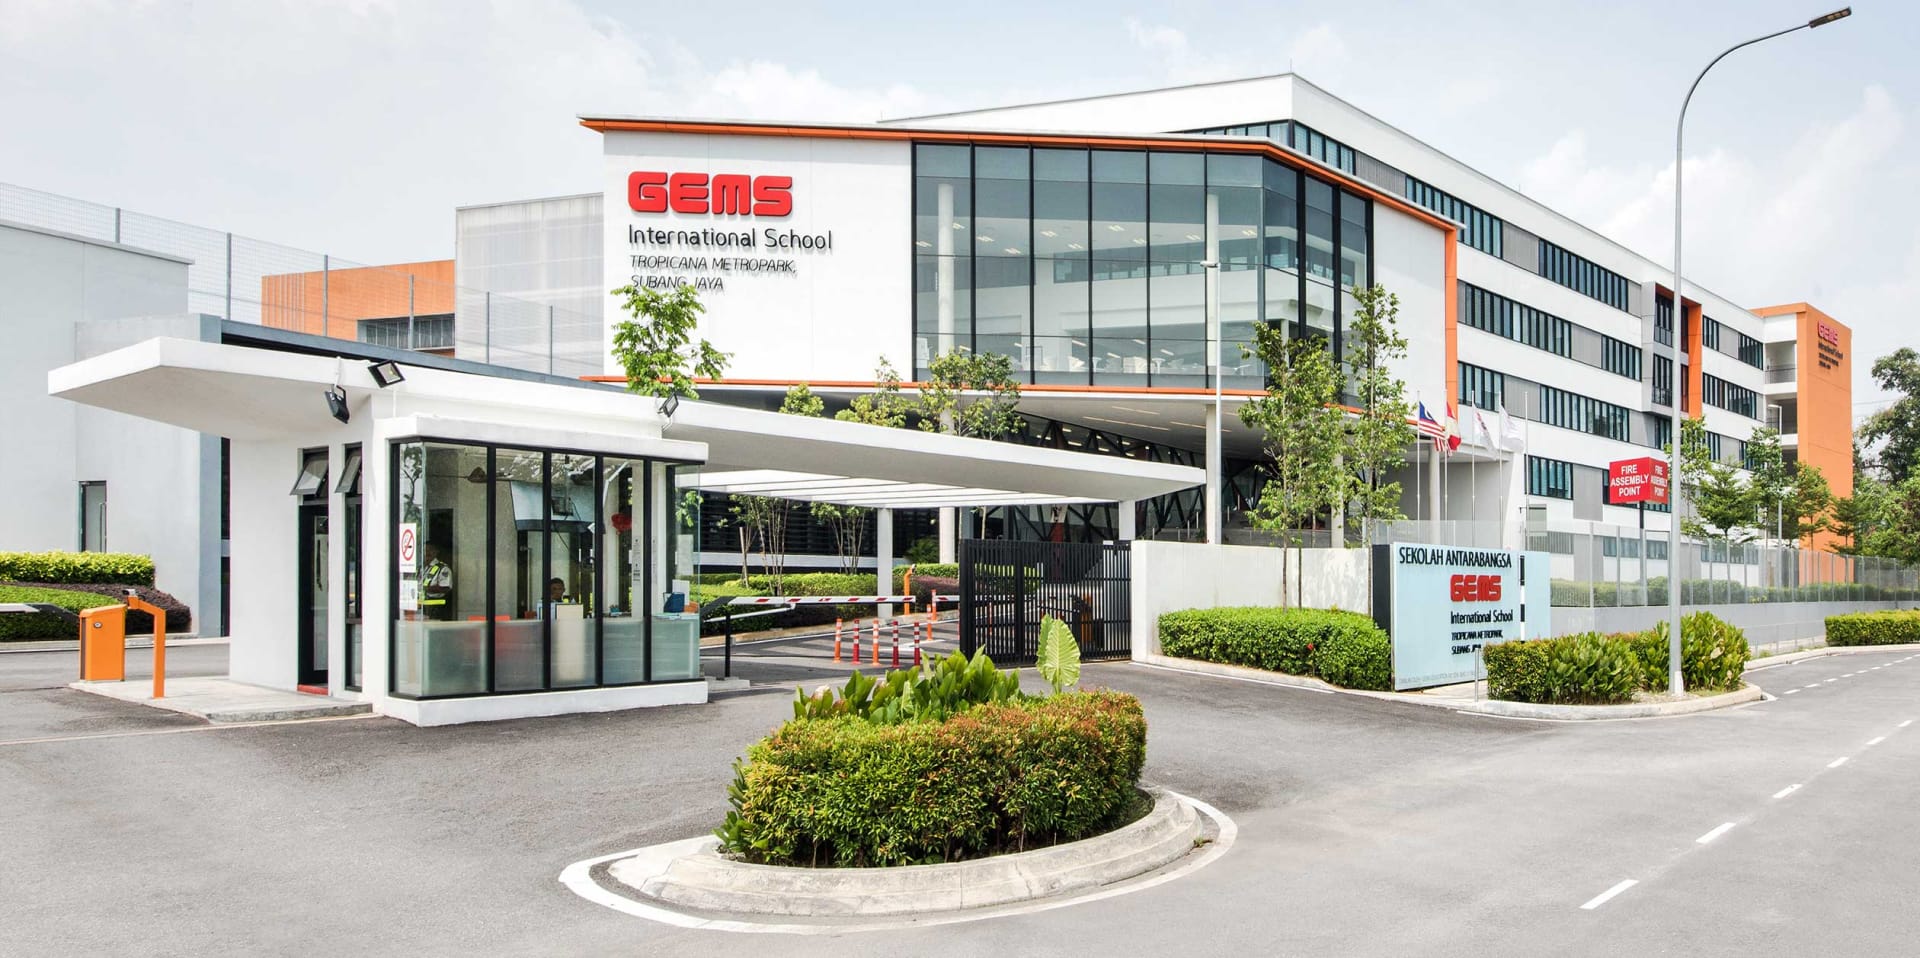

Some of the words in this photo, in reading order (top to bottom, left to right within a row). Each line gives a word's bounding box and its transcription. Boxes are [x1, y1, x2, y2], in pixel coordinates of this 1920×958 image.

[628, 171, 793, 217] GEMS
[629, 224, 756, 248] International
[764, 228, 832, 249] School
[630, 254, 707, 270] TROPICANA
[711, 257, 797, 273] METROPARK,
[631, 274, 687, 289] SUBANG
[1621, 464, 1638, 475] FIRE
[1610, 474, 1649, 487] ASSEMBLY
[1618, 485, 1641, 497] POINT
[1399, 546, 1443, 566] SEKOLAH
[1445, 549, 1512, 568] ANTARABANGSA
[1450, 574, 1501, 602] GEMS
[1451, 609, 1491, 624] International
[1493, 609, 1513, 622] School
